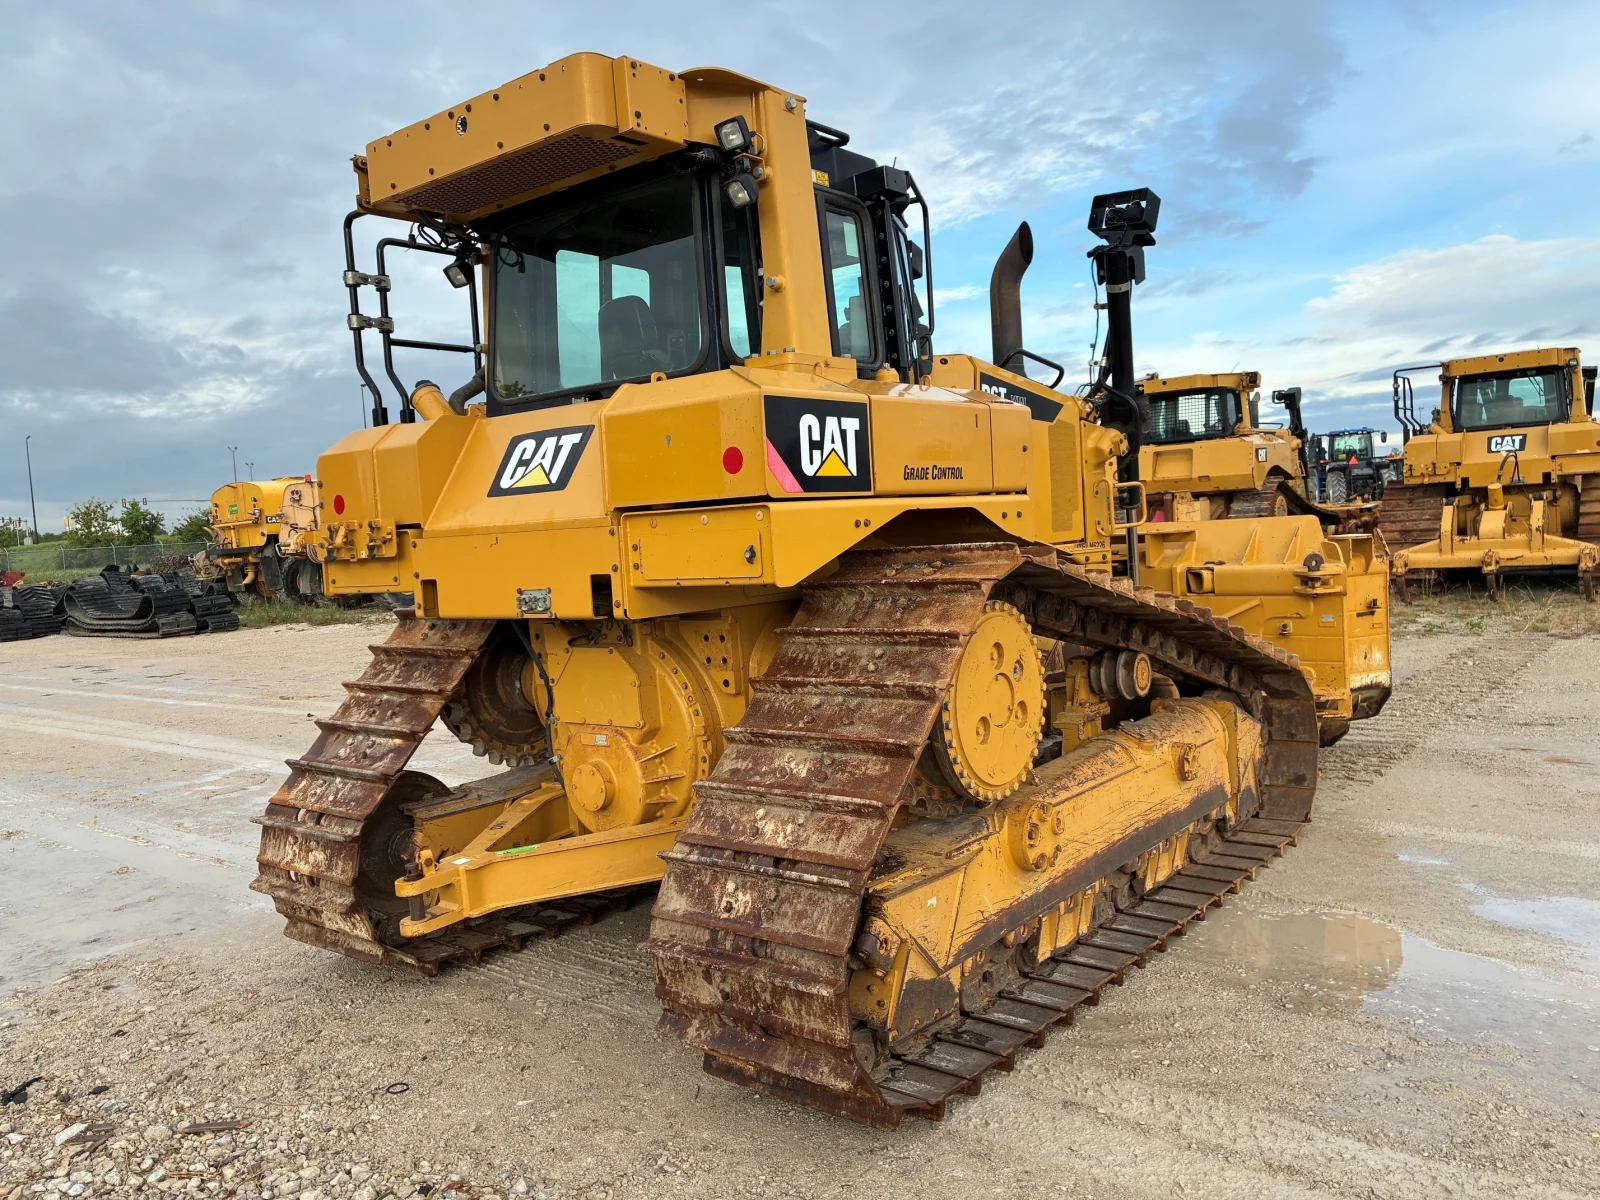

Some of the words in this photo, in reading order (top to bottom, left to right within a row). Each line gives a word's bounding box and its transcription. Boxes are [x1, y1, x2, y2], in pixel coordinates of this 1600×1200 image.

[500, 432, 583, 489] CAT
[799, 413, 860, 476] CAT
[1490, 435, 1523, 452] CAT
[903, 464, 930, 481] GRADE
[931, 464, 964, 480] CONTROL
